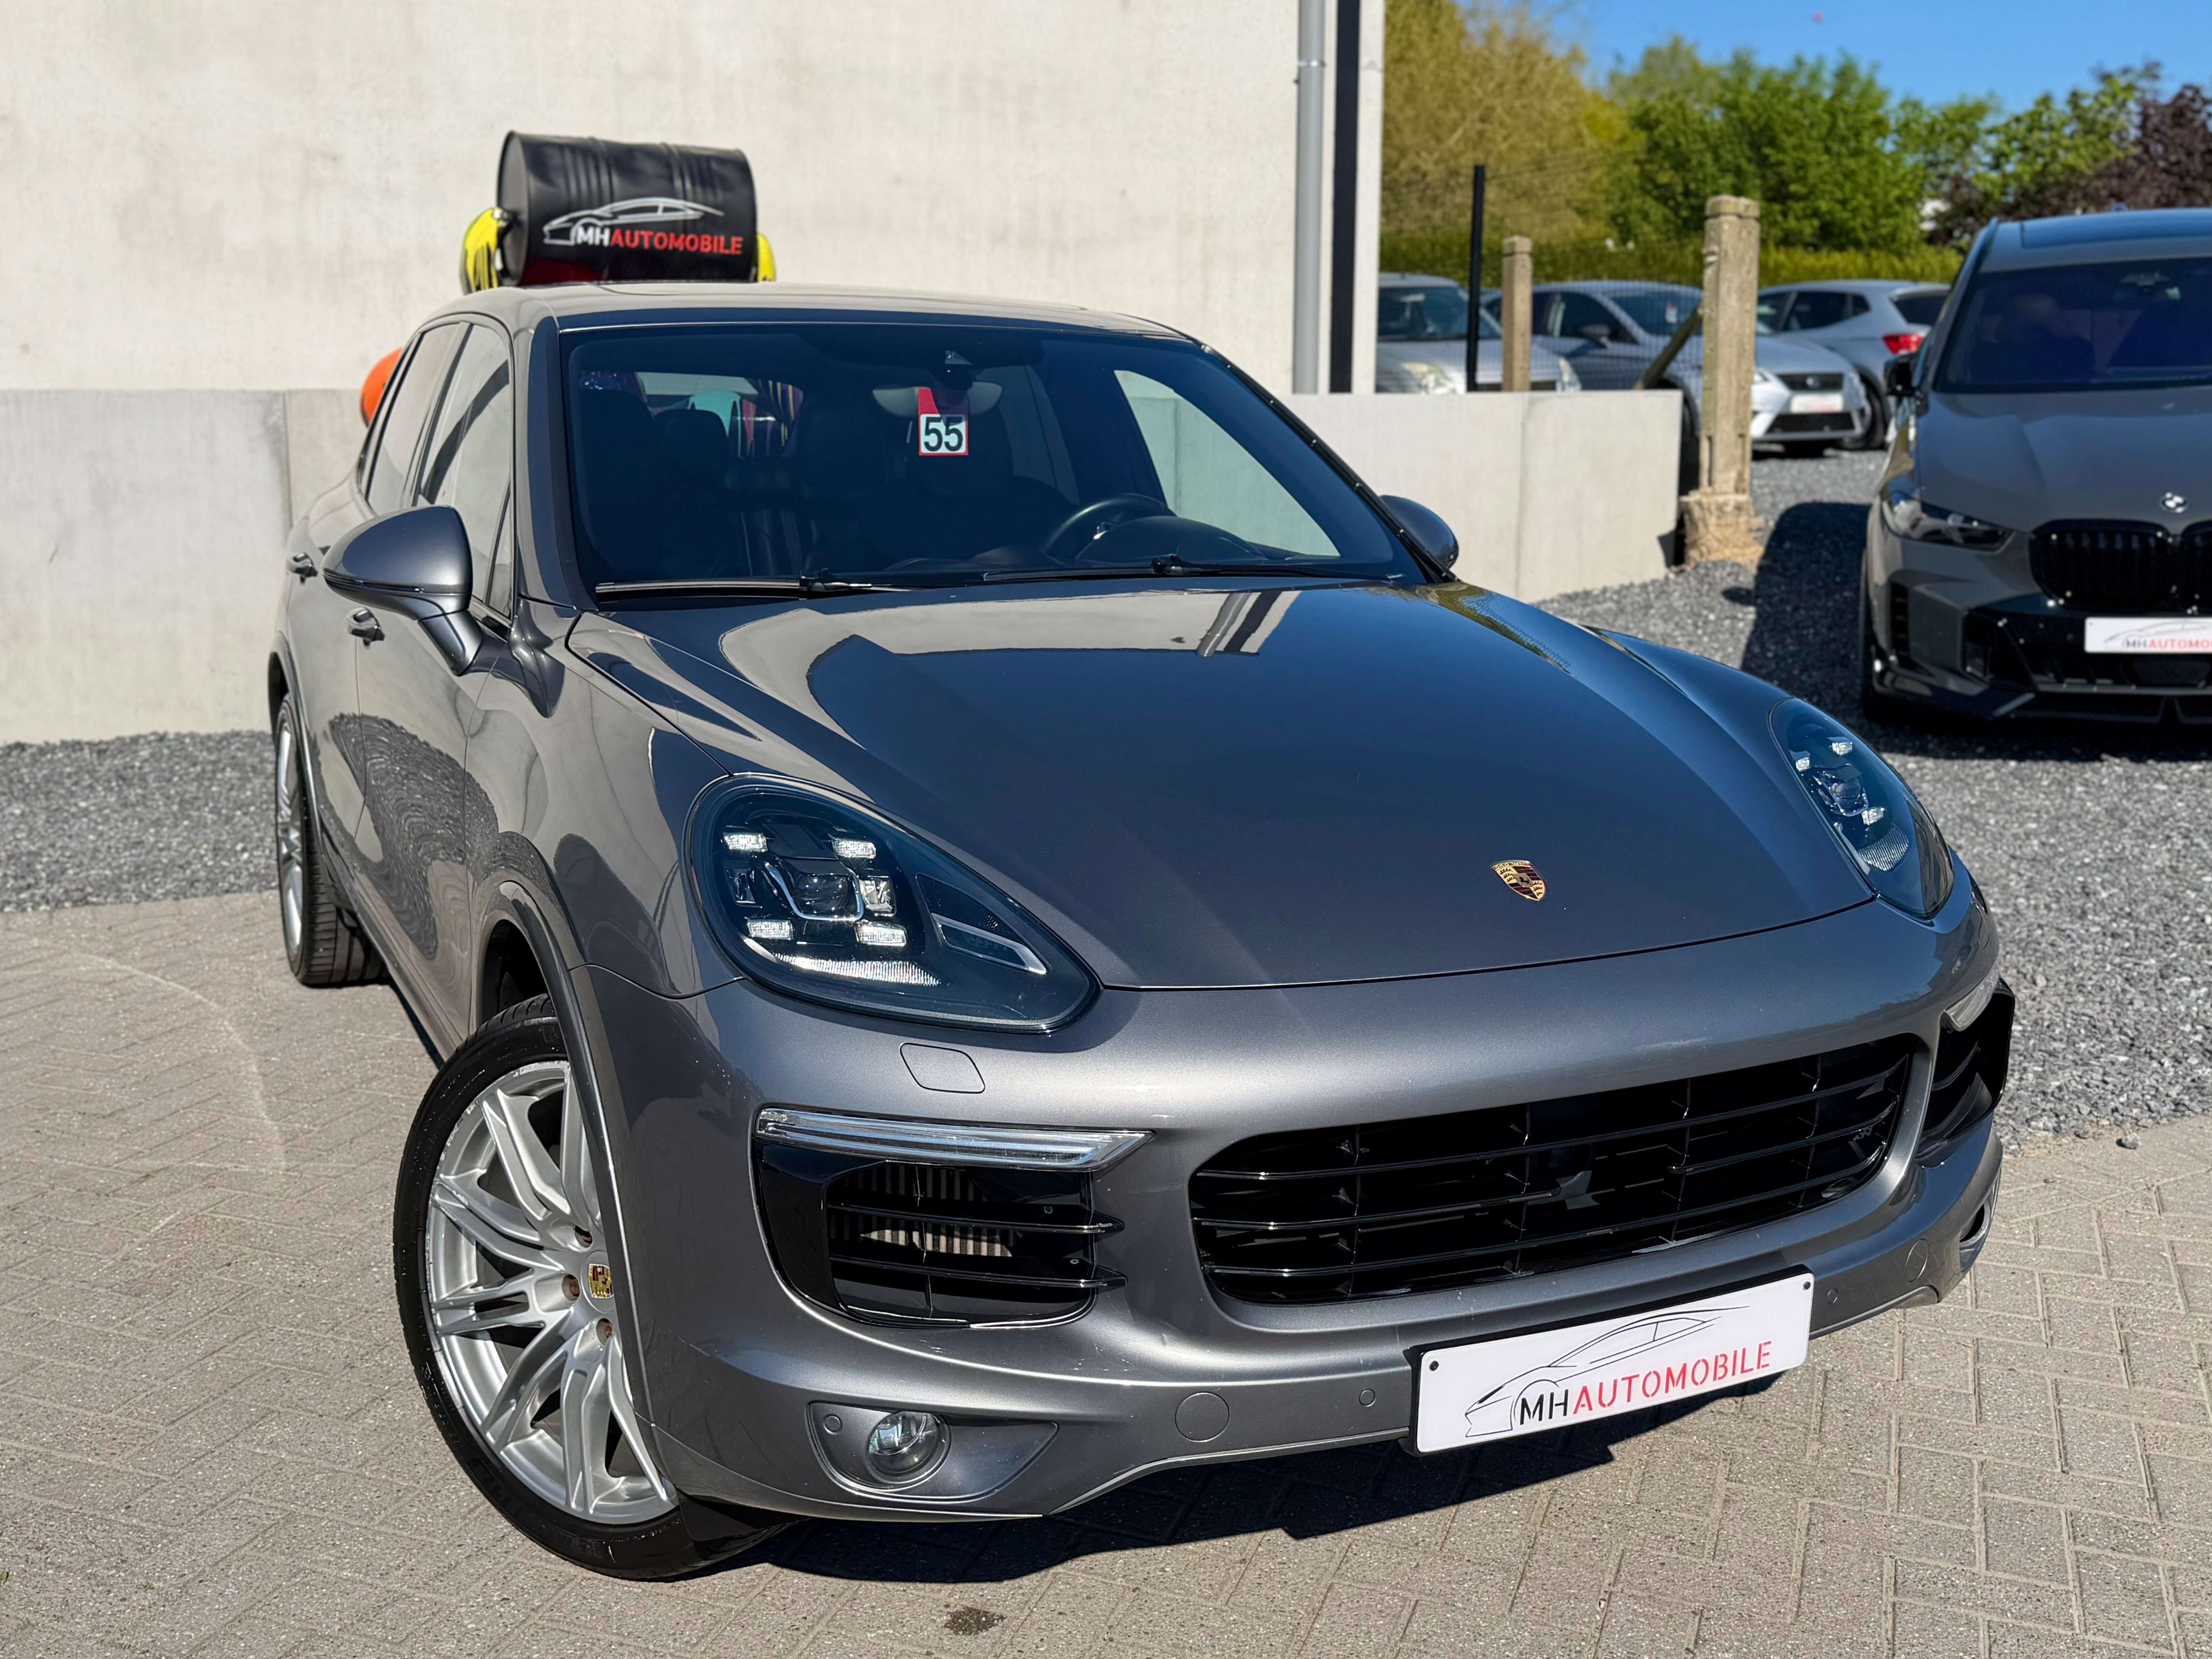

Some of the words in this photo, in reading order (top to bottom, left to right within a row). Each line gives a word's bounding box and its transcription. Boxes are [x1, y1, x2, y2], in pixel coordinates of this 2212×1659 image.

[576, 226, 743, 254] MHAUTOMOBILE
[923, 416, 963, 452] 55
[2126, 639, 2212, 648] MHAUTOMO
[1520, 1340, 1772, 1425] MHAUTOMOBILE
